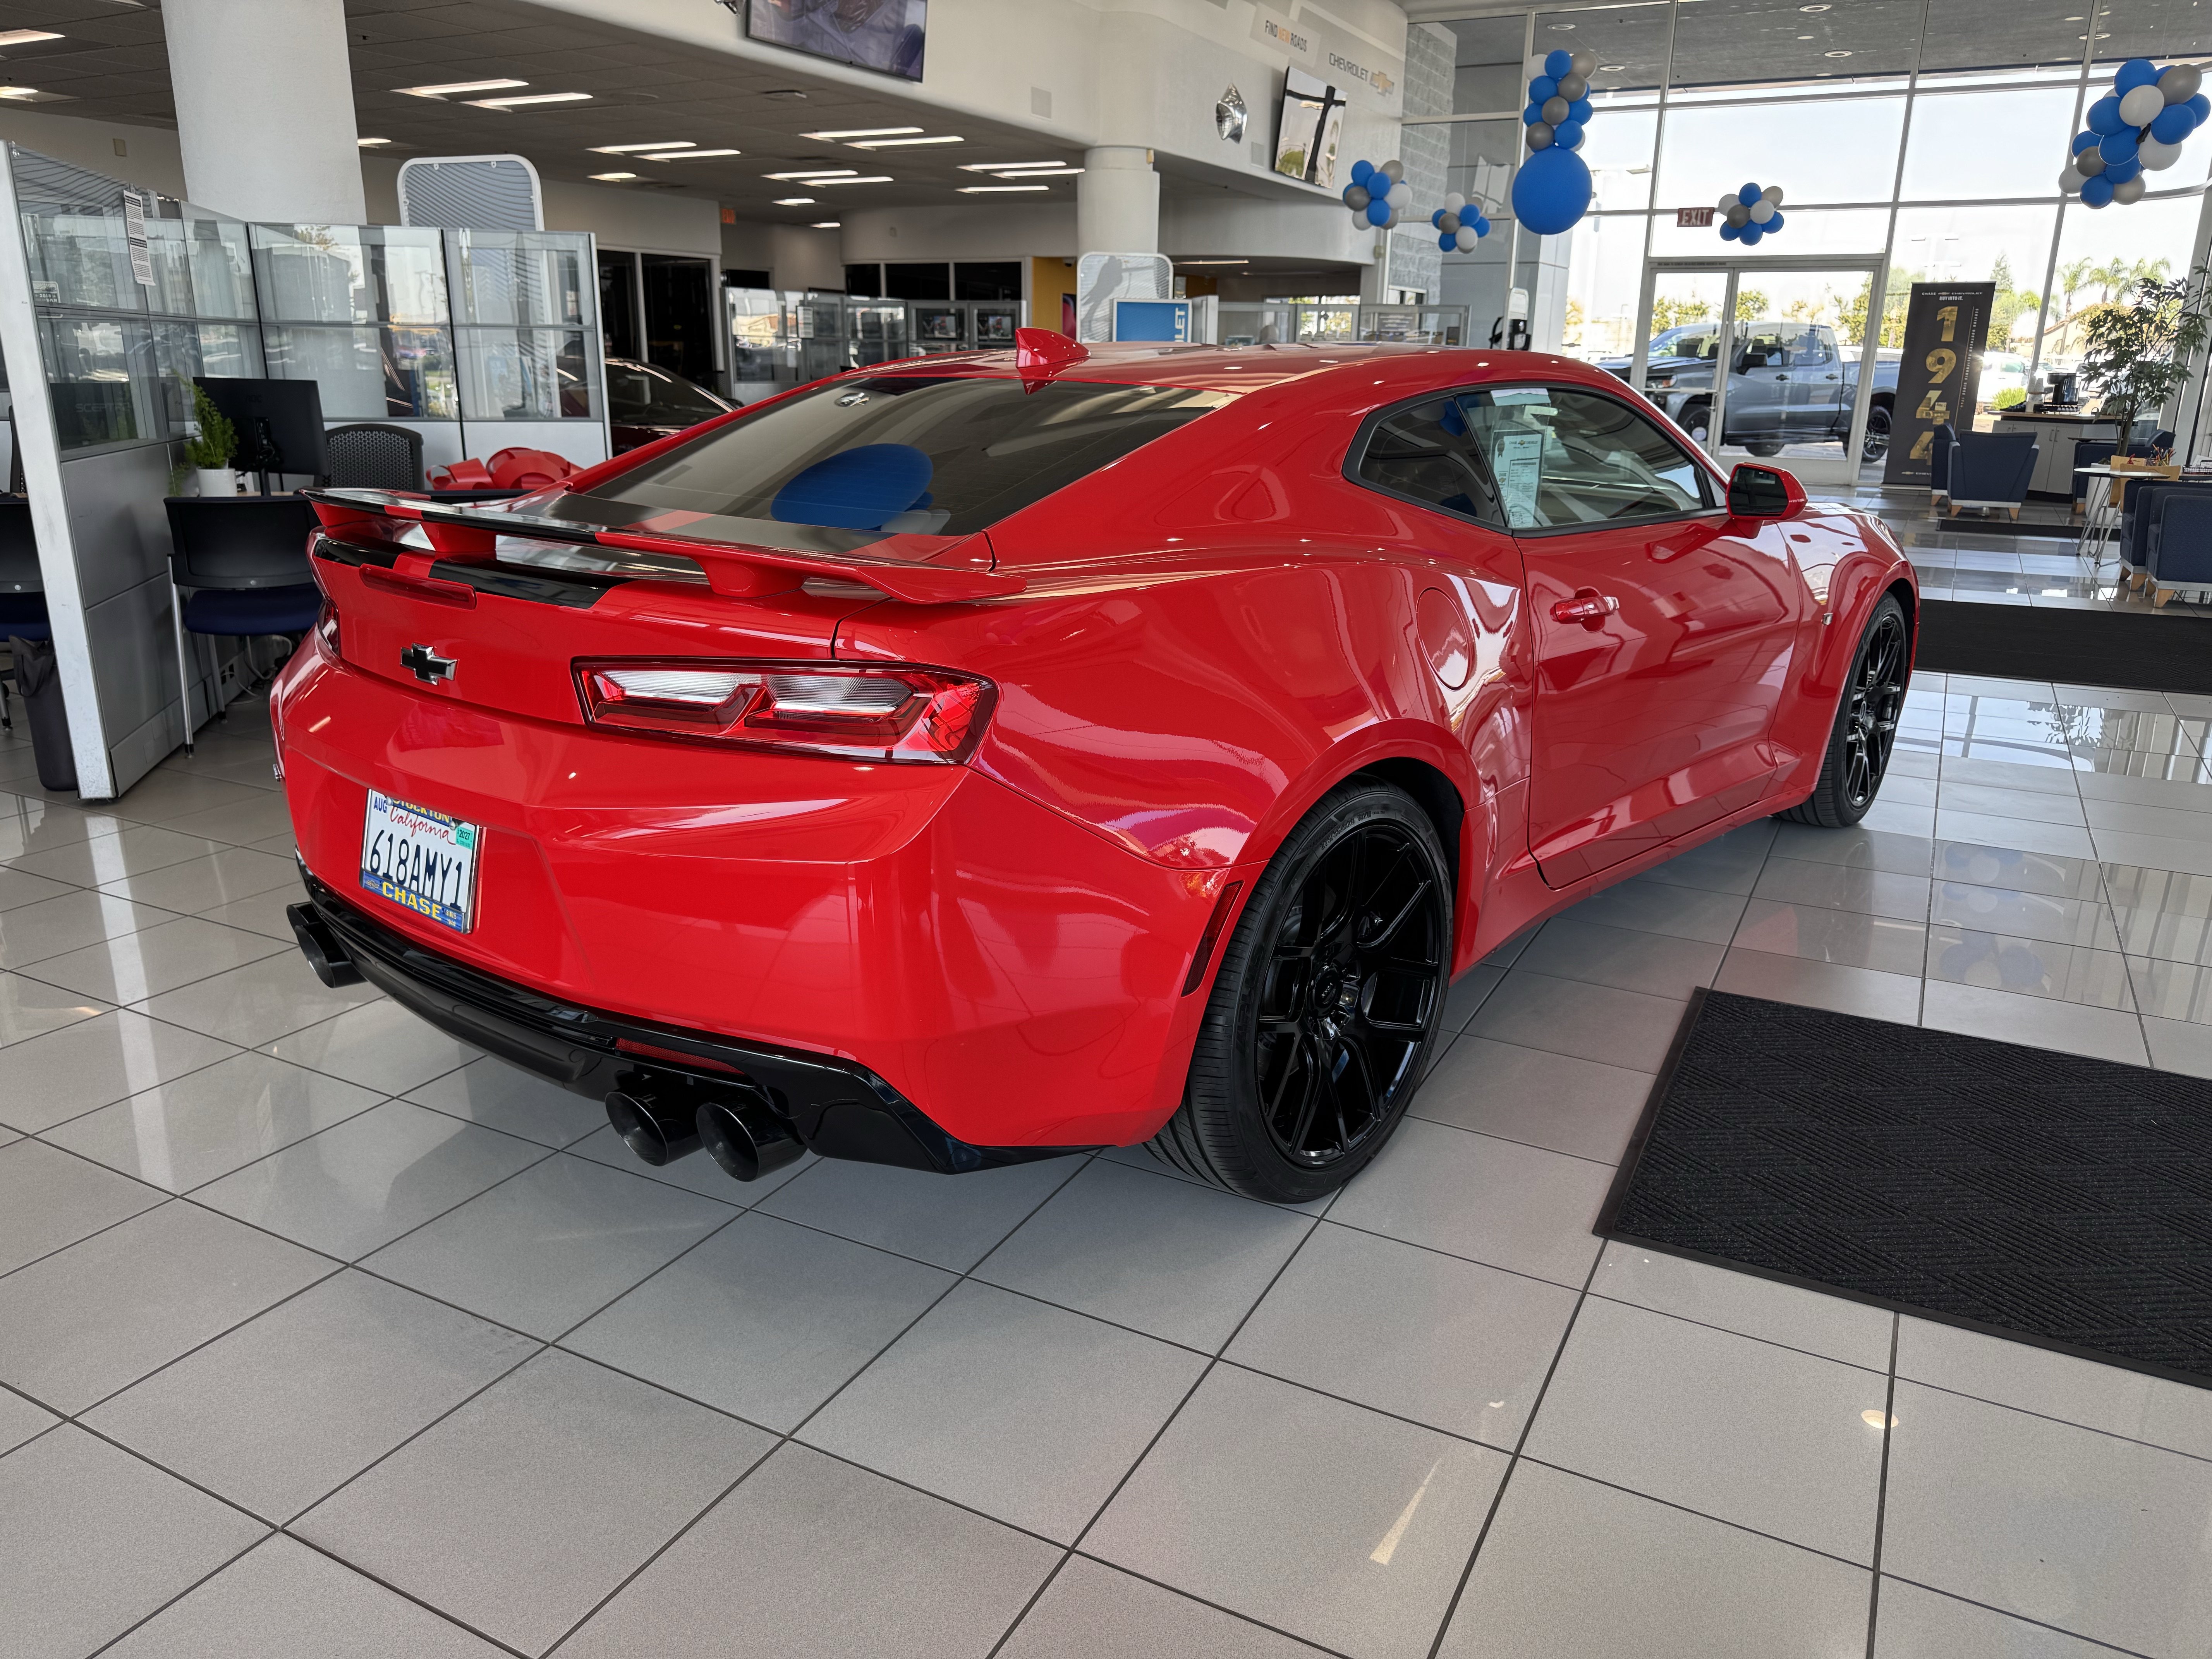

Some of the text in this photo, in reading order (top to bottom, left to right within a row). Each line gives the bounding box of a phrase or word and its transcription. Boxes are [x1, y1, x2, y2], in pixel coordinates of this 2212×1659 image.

[1265, 20, 1278, 38] FIND
[1290, 33, 1307, 52] ROADS
[1329, 53, 1369, 82] CHEVROLET
[1681, 210, 1709, 225] EXIT
[1175, 307, 1185, 342] LET
[374, 797, 387, 813] AUG
[390, 807, 456, 845] California
[459, 830, 471, 840] 2027
[370, 830, 462, 909] 618AMY1
[382, 882, 442, 921] CHASE
